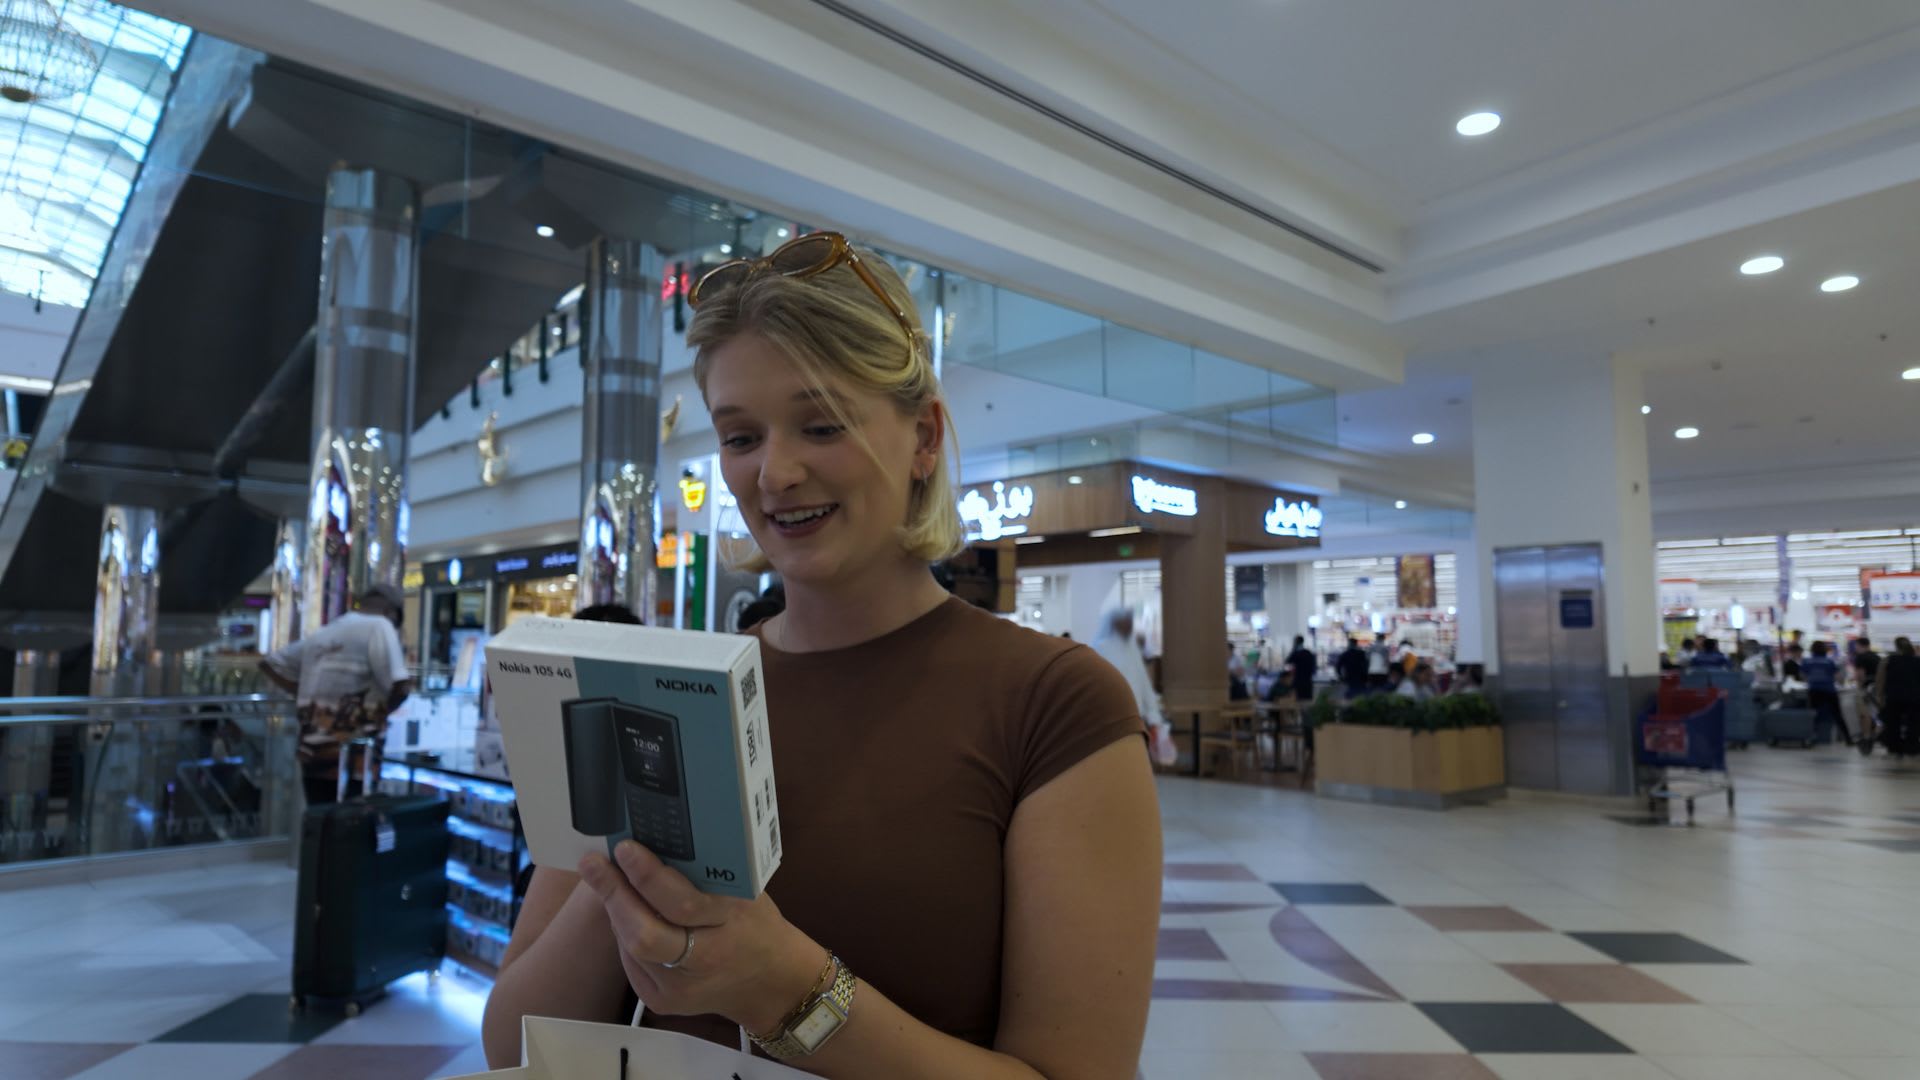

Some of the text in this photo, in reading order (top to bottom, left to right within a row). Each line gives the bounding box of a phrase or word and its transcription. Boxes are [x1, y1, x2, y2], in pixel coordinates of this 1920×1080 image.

[499, 661, 573, 679] Nokia 105 4G
[655, 677, 718, 695] NOKIA
[705, 865, 735, 881] HMD
